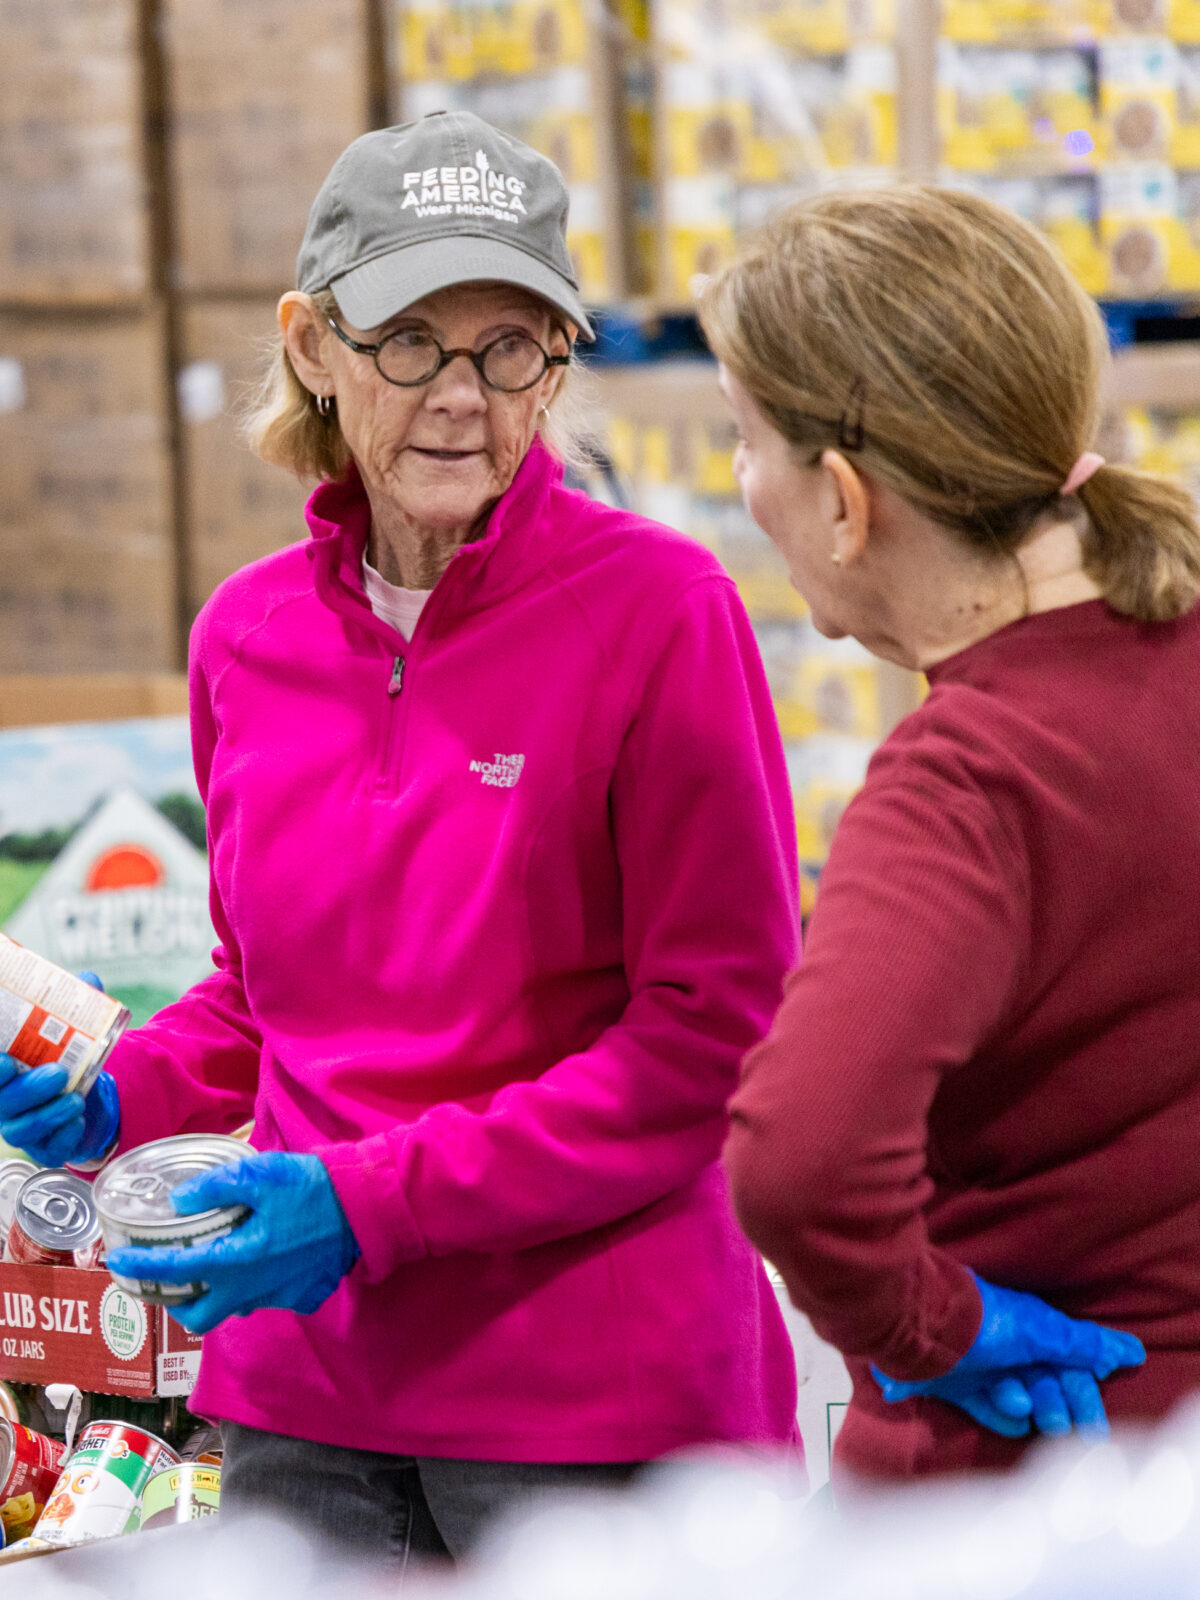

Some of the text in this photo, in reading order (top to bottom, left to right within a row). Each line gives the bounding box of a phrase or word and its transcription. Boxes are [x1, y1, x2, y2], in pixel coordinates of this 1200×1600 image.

[402, 166, 524, 196] FEEDING
[400, 184, 528, 215] AMERICA
[414, 203, 519, 224] West Michigan
[468, 759, 519, 777] NORTH
[493, 752, 518, 766] THE
[481, 773, 516, 788] FACE
[39, 1296, 93, 1335] SIZE
[108, 1313, 135, 1333] PROTEIN
[2, 1338, 19, 1357] OZ
[20, 1340, 46, 1360] JARS
[163, 1356, 185, 1368] BEST IF
[163, 1371, 178, 1382] USED
[161, 1450, 177, 1466] Nutri
